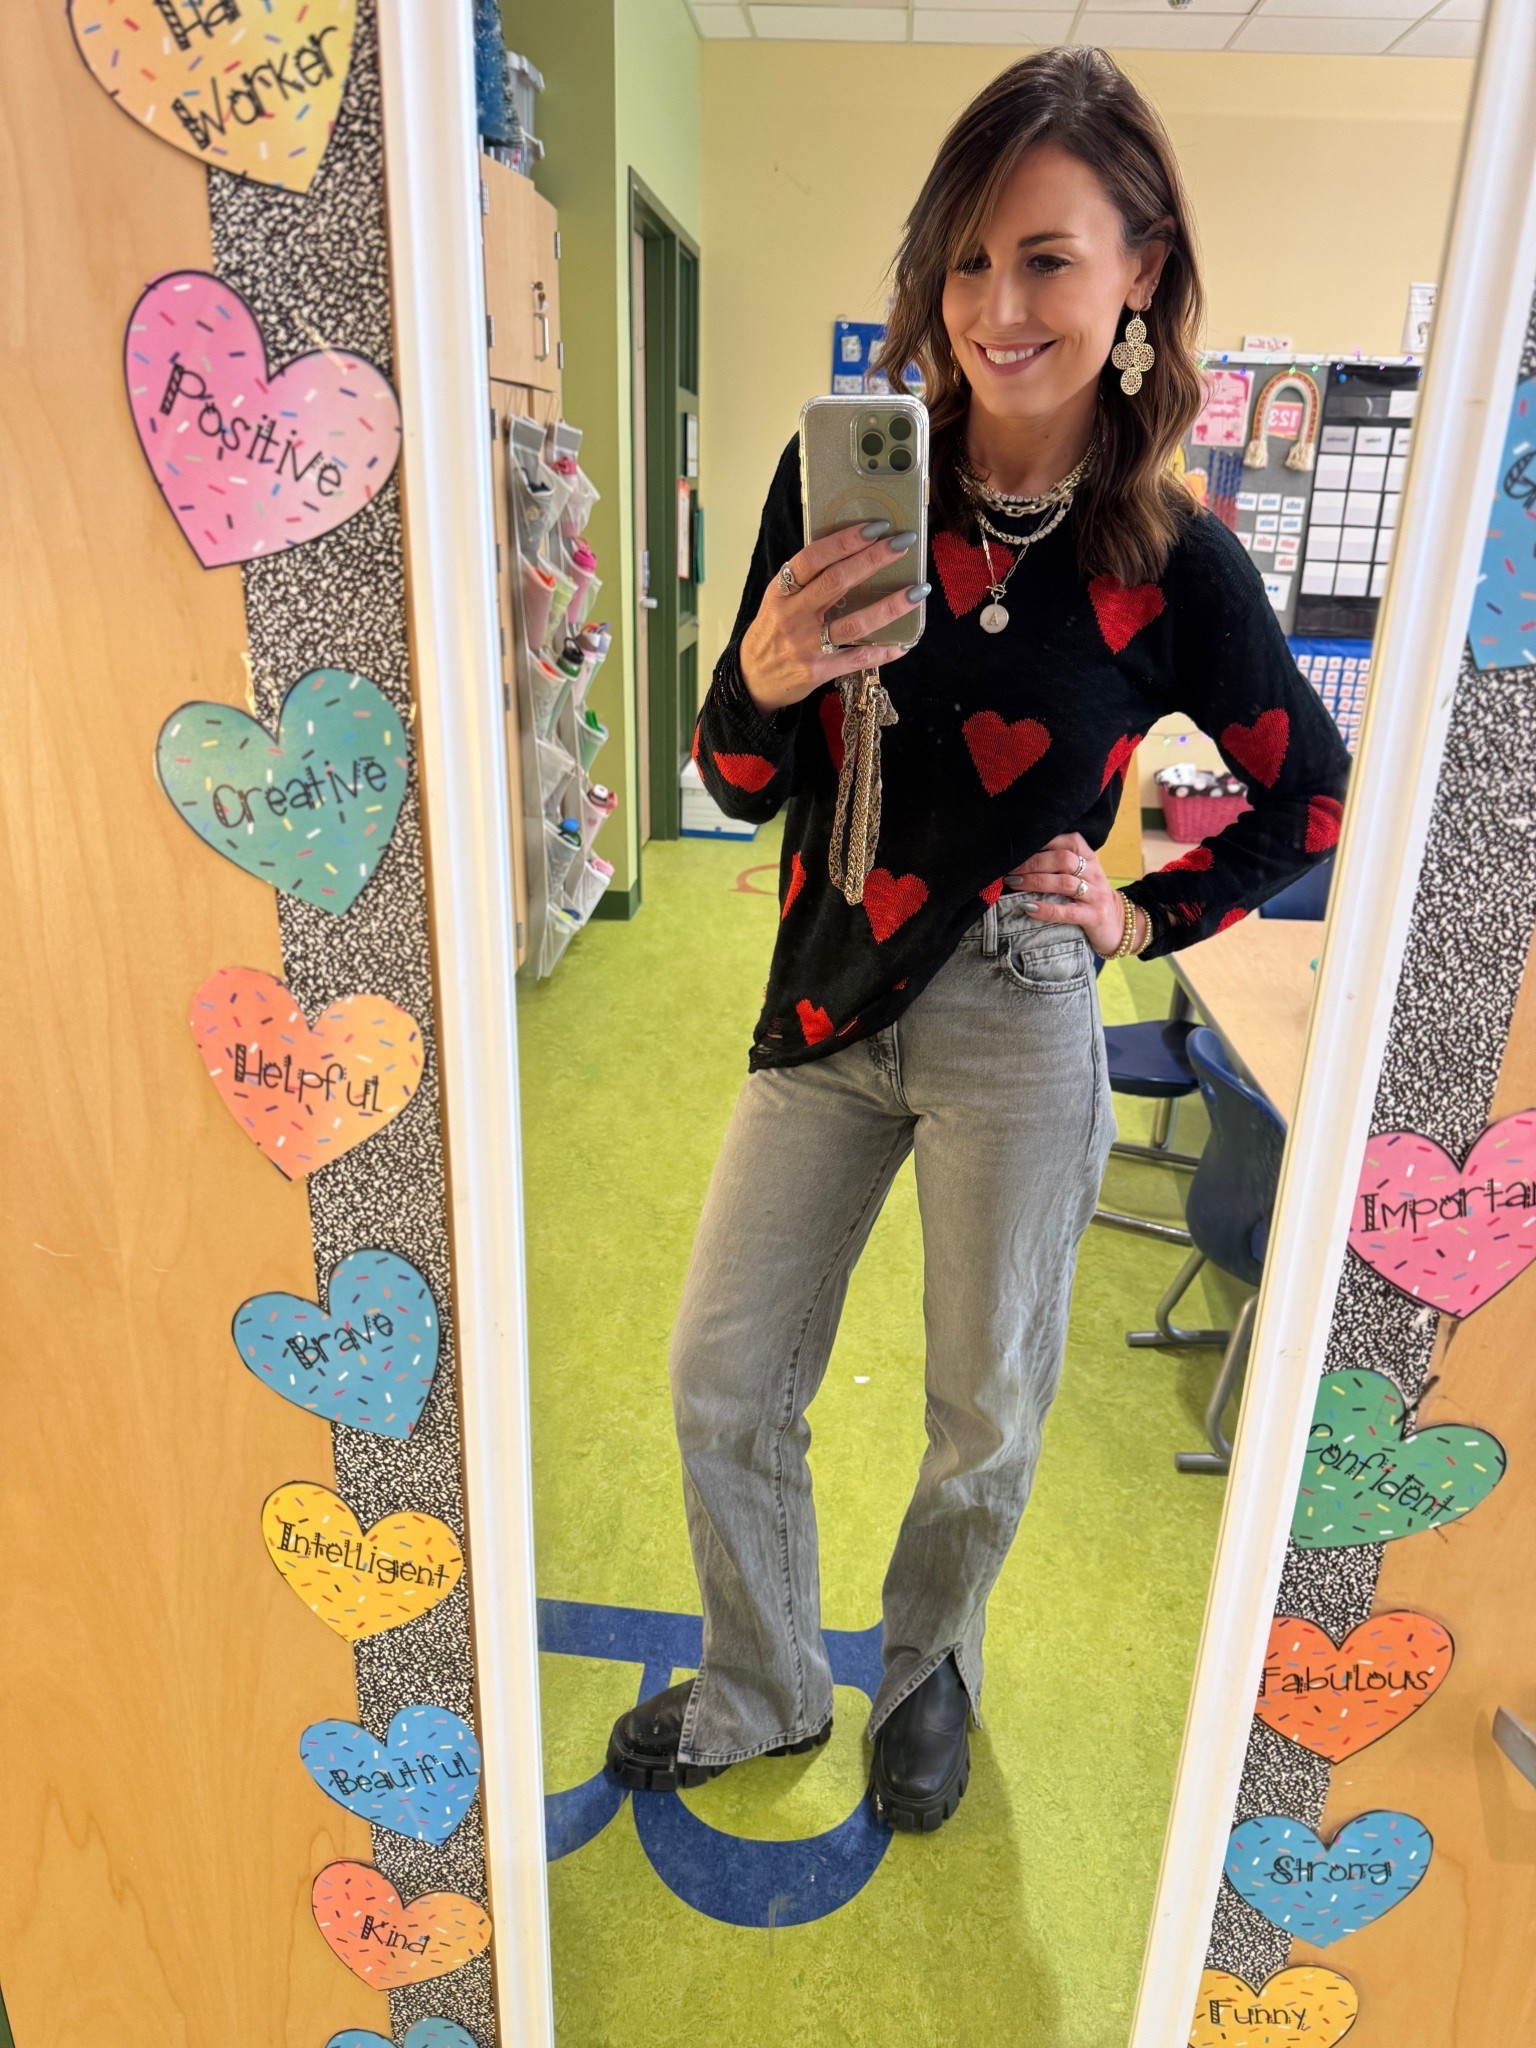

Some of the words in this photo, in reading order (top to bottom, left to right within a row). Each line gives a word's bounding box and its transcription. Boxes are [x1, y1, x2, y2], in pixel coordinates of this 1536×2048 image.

[153, 0, 241, 51] Ha
[171, 26, 338, 150] Worker
[160, 364, 342, 497] Positive
[212, 756, 387, 828] Creative
[234, 1044, 383, 1112] Helpful
[1361, 1178, 1536, 1233] Importa
[287, 1313, 393, 1370] Brave
[1306, 1424, 1454, 1521] Confident
[277, 1522, 450, 1589] Intelligent
[1257, 1665, 1433, 1698] Fabulous
[330, 1751, 476, 1796] Beautiful
[1272, 1854, 1392, 1885] Strong
[361, 1915, 430, 1955] Kind
[1209, 2000, 1307, 2031] Funny
